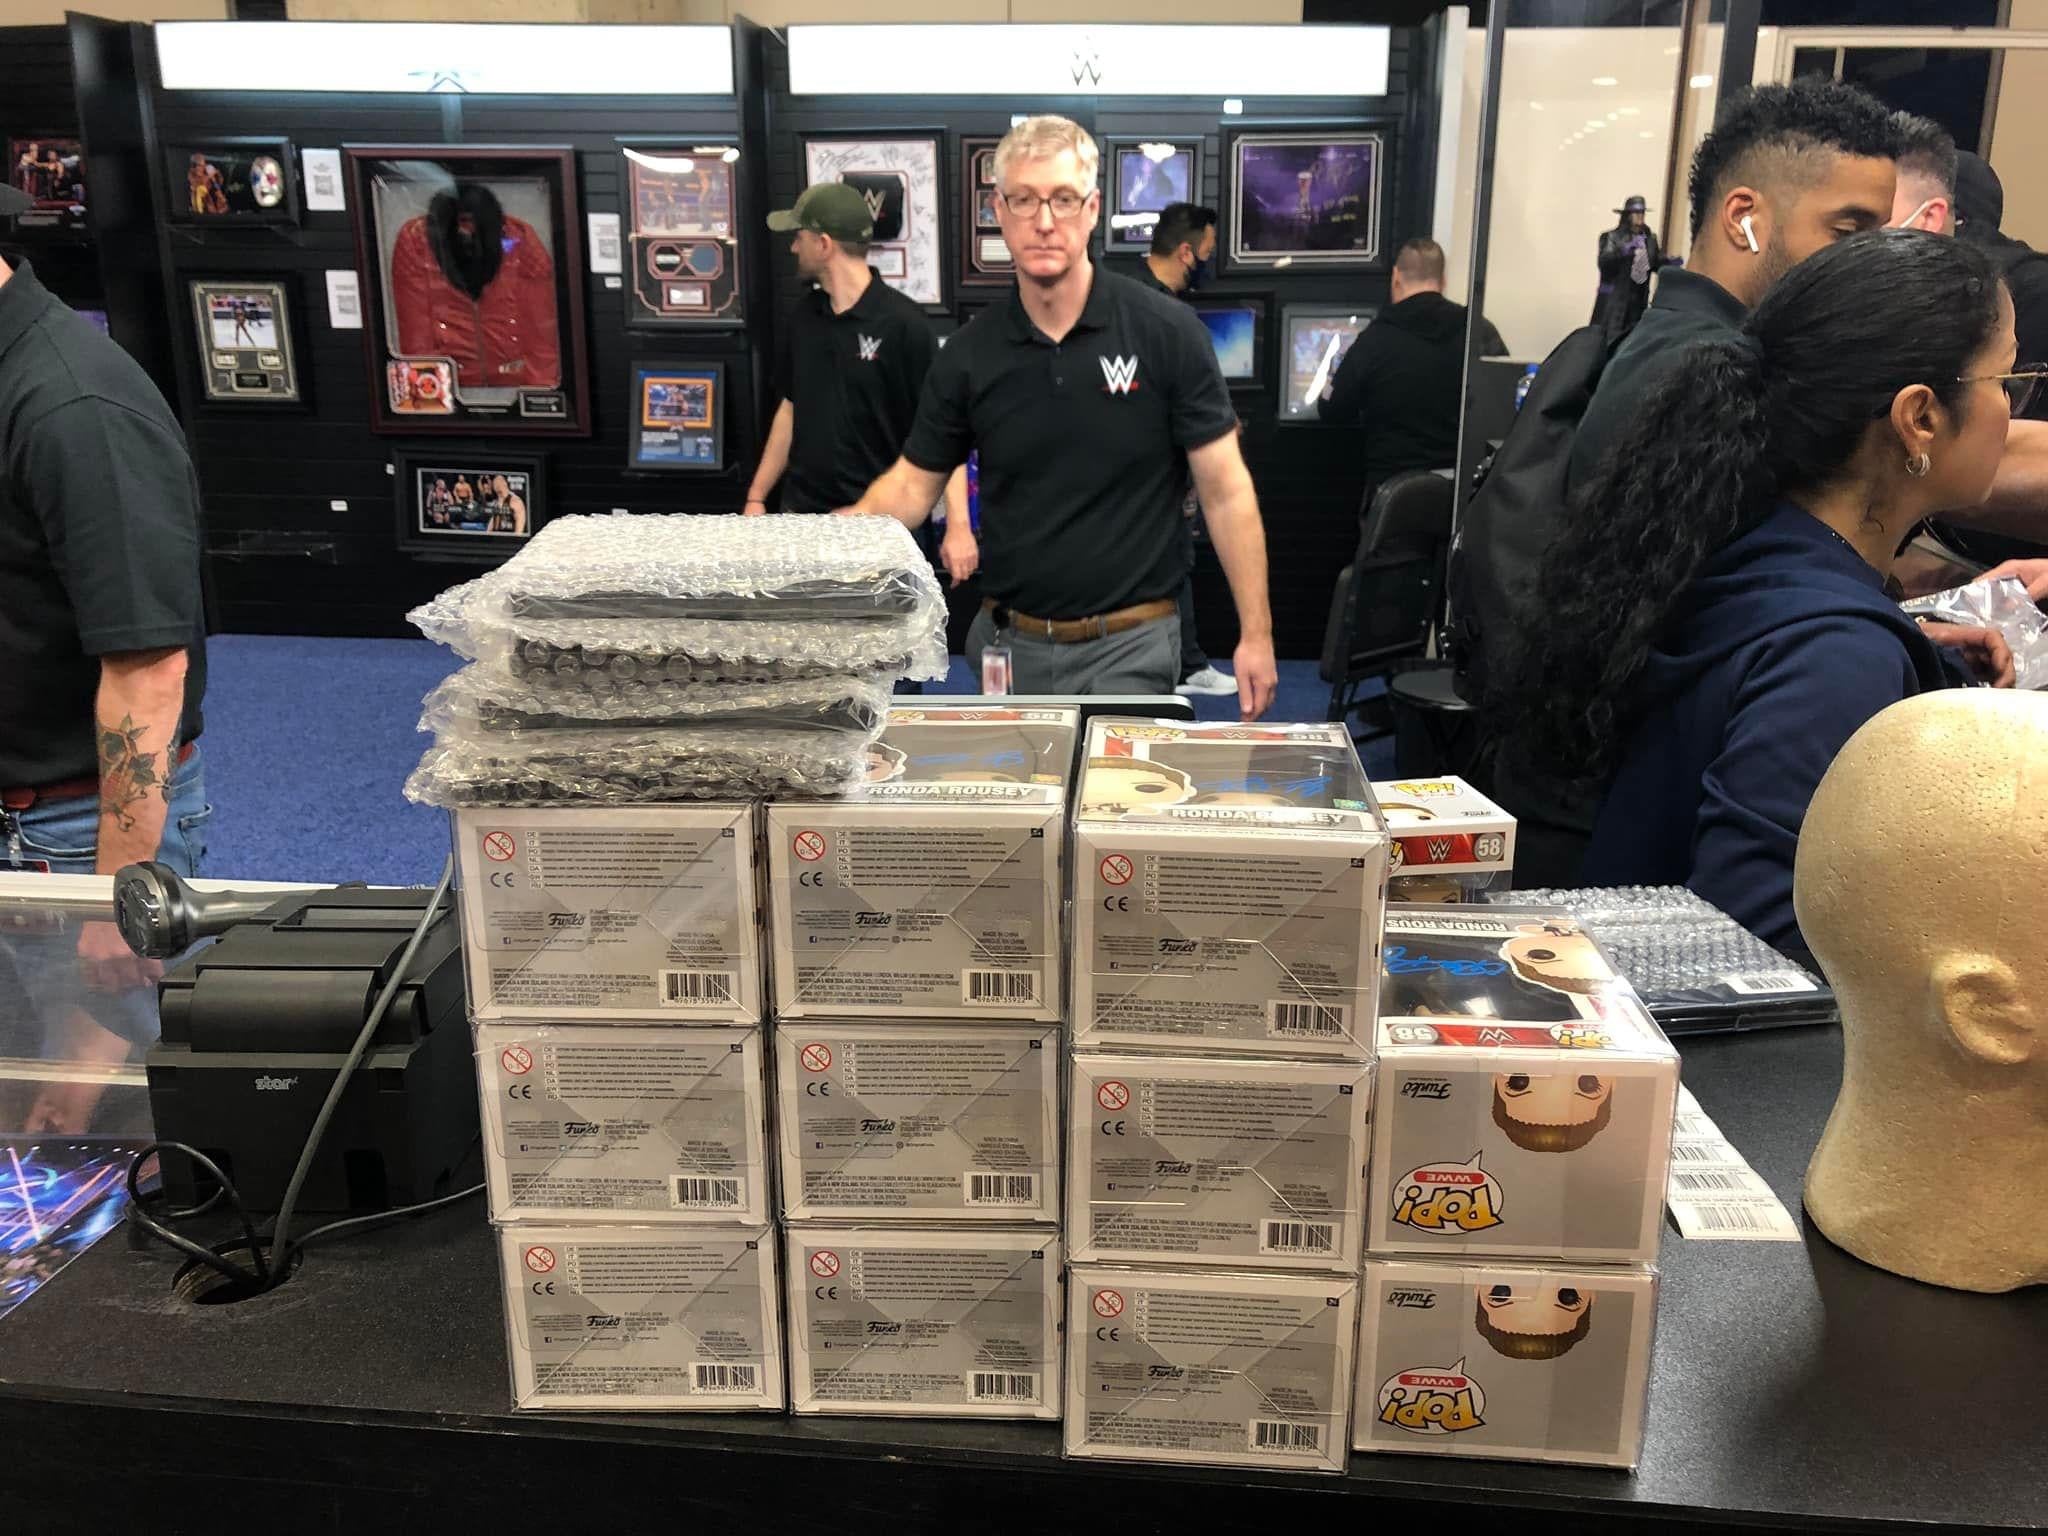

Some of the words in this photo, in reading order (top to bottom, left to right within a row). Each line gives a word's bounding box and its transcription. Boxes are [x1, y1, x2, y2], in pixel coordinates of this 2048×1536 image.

[868, 785, 940, 795] RONDA
[948, 786, 1032, 796] ROUSEY
[1171, 809, 1247, 820] RONDA
[1478, 838, 1501, 858] 58
[490, 872, 514, 888] CE
[800, 872, 823, 887] CE
[1104, 896, 1128, 912] CE
[548, 912, 586, 926] Funko
[855, 911, 892, 925] Funko
[1386, 919, 1438, 929] ROUS
[1158, 938, 1197, 952] Funko
[1395, 1026, 1428, 1039] 58
[508, 1084, 532, 1099] CE
[806, 1081, 830, 1096] CE
[1402, 1082, 1453, 1099] Funko
[860, 1119, 896, 1132] Funko
[1101, 1120, 1125, 1136] CE
[1426, 1173, 1472, 1183] WWE
[1392, 1184, 1504, 1232] POP!
[533, 1282, 555, 1295] CE
[815, 1286, 839, 1300] CE
[1387, 1291, 1437, 1309] Funko
[1096, 1327, 1119, 1342] CE
[1410, 1376, 1455, 1387] WWE
[1378, 1387, 1487, 1432] POP!
